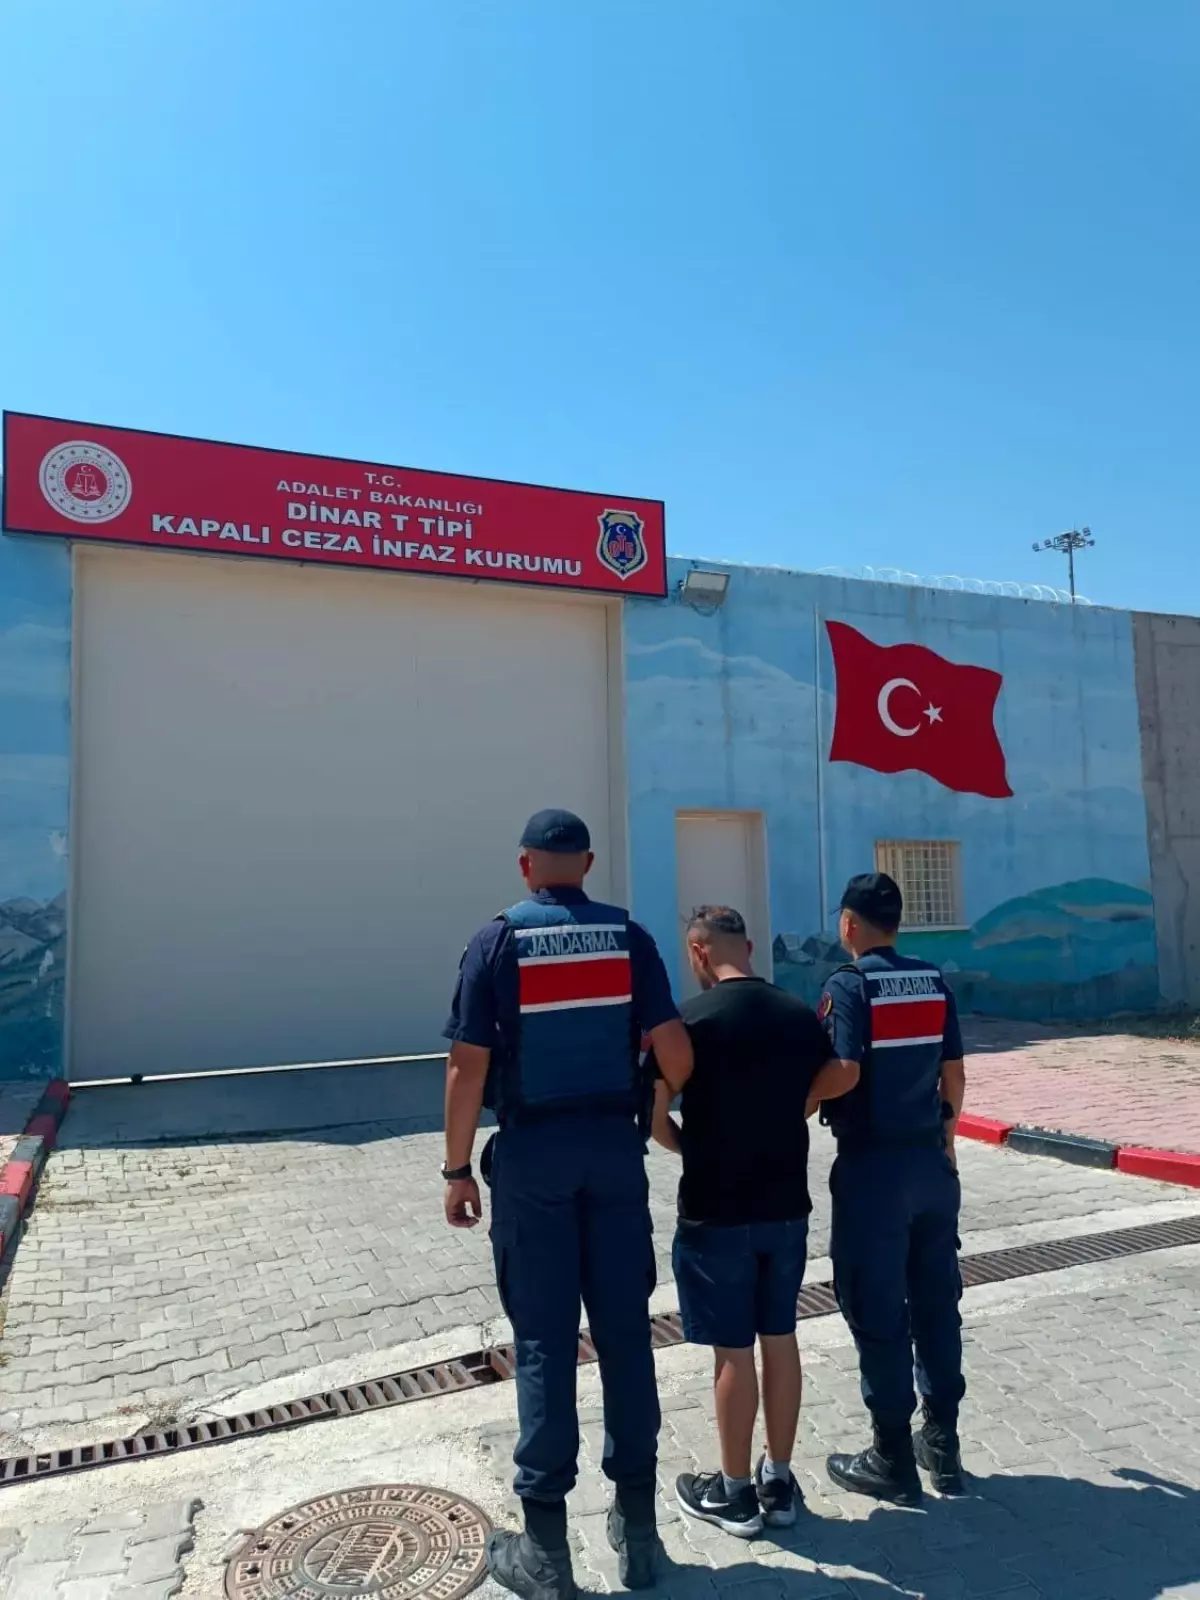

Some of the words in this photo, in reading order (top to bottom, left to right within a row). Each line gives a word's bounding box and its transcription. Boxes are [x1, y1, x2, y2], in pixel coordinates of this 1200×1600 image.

[276, 480, 362, 500] ADALET
[364, 472, 401, 488] T.C.
[287, 501, 382, 530] DİNAR
[391, 514, 409, 531] T
[418, 516, 473, 540] TİPİ
[152, 514, 270, 544] KAPALI
[281, 529, 362, 554] CEZA
[373, 534, 456, 563] İNFAZ
[466, 548, 582, 577] KURUMU
[527, 931, 619, 957] JANDARMA
[878, 976, 938, 997] JANDARMA
